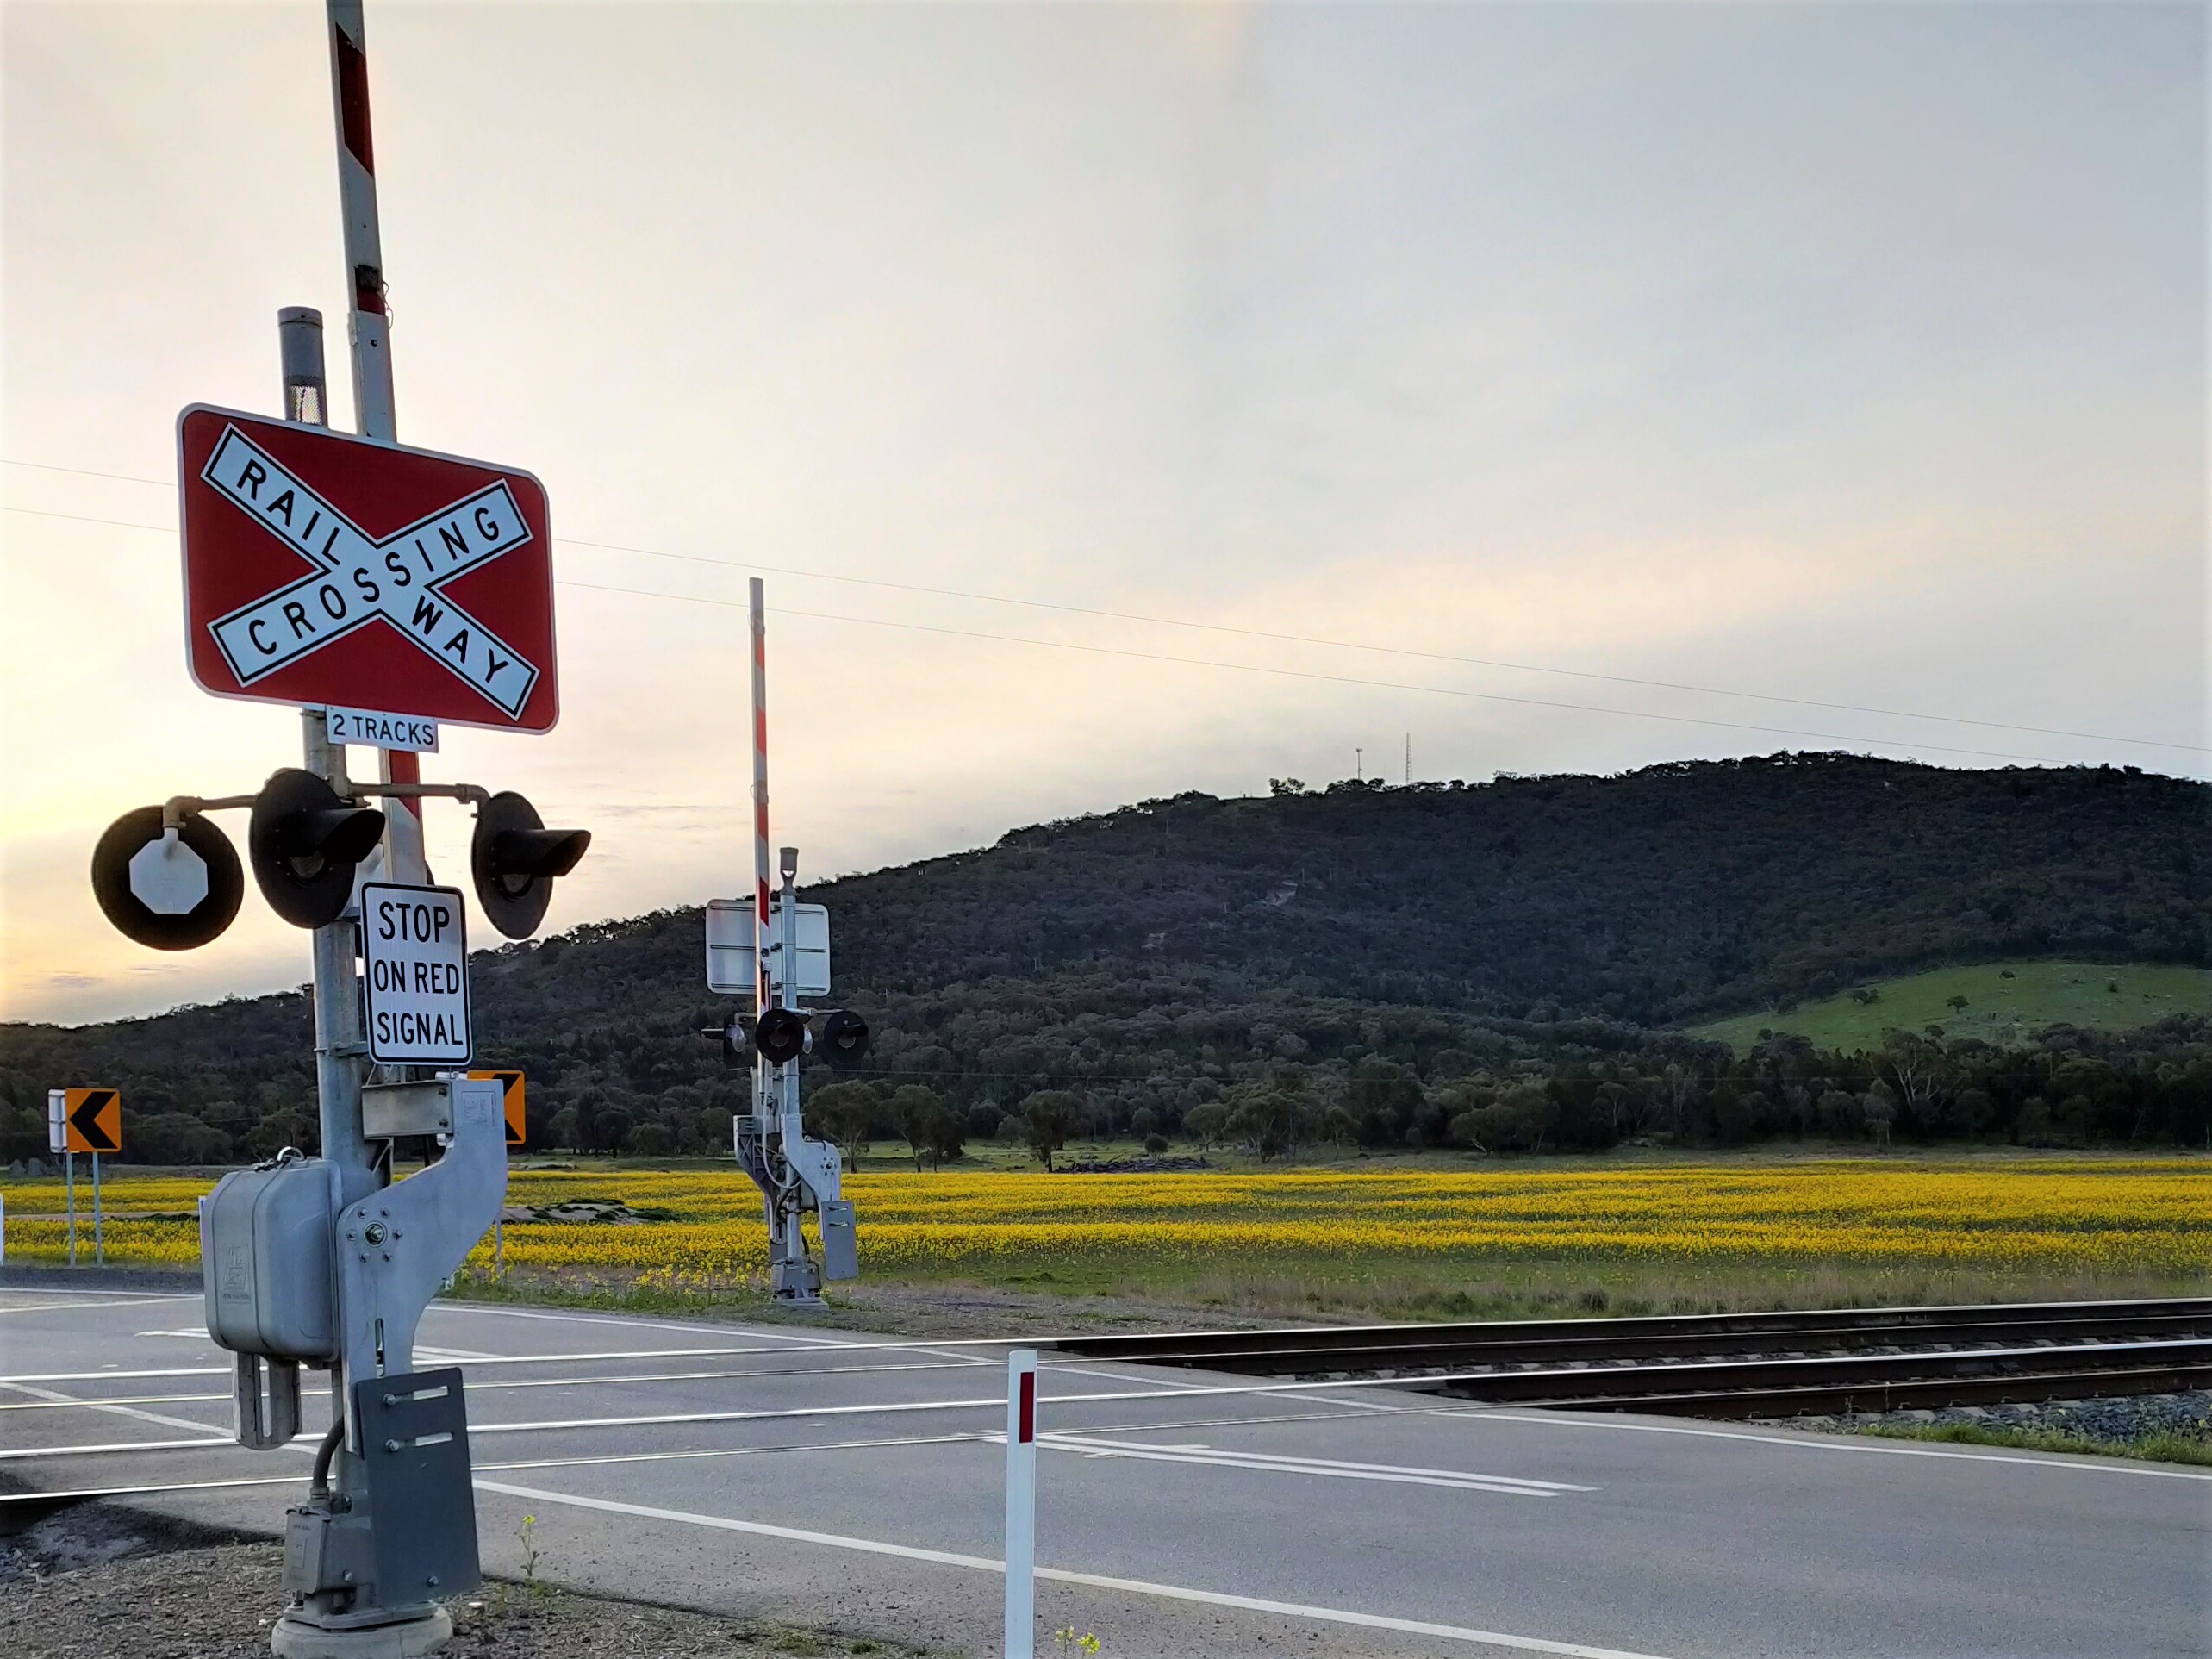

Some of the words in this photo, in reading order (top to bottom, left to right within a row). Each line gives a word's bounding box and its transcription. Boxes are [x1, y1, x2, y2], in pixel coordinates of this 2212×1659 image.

[236, 458, 341, 566] RAIL
[248, 507, 500, 656] CROSSING
[411, 594, 510, 684] WAY
[332, 714, 346, 736] 2
[352, 715, 434, 746] TRACKS
[377, 901, 452, 944] STOP
[373, 959, 407, 993] ON
[414, 961, 460, 995] RED
[377, 1011, 464, 1045] SIGNAL
